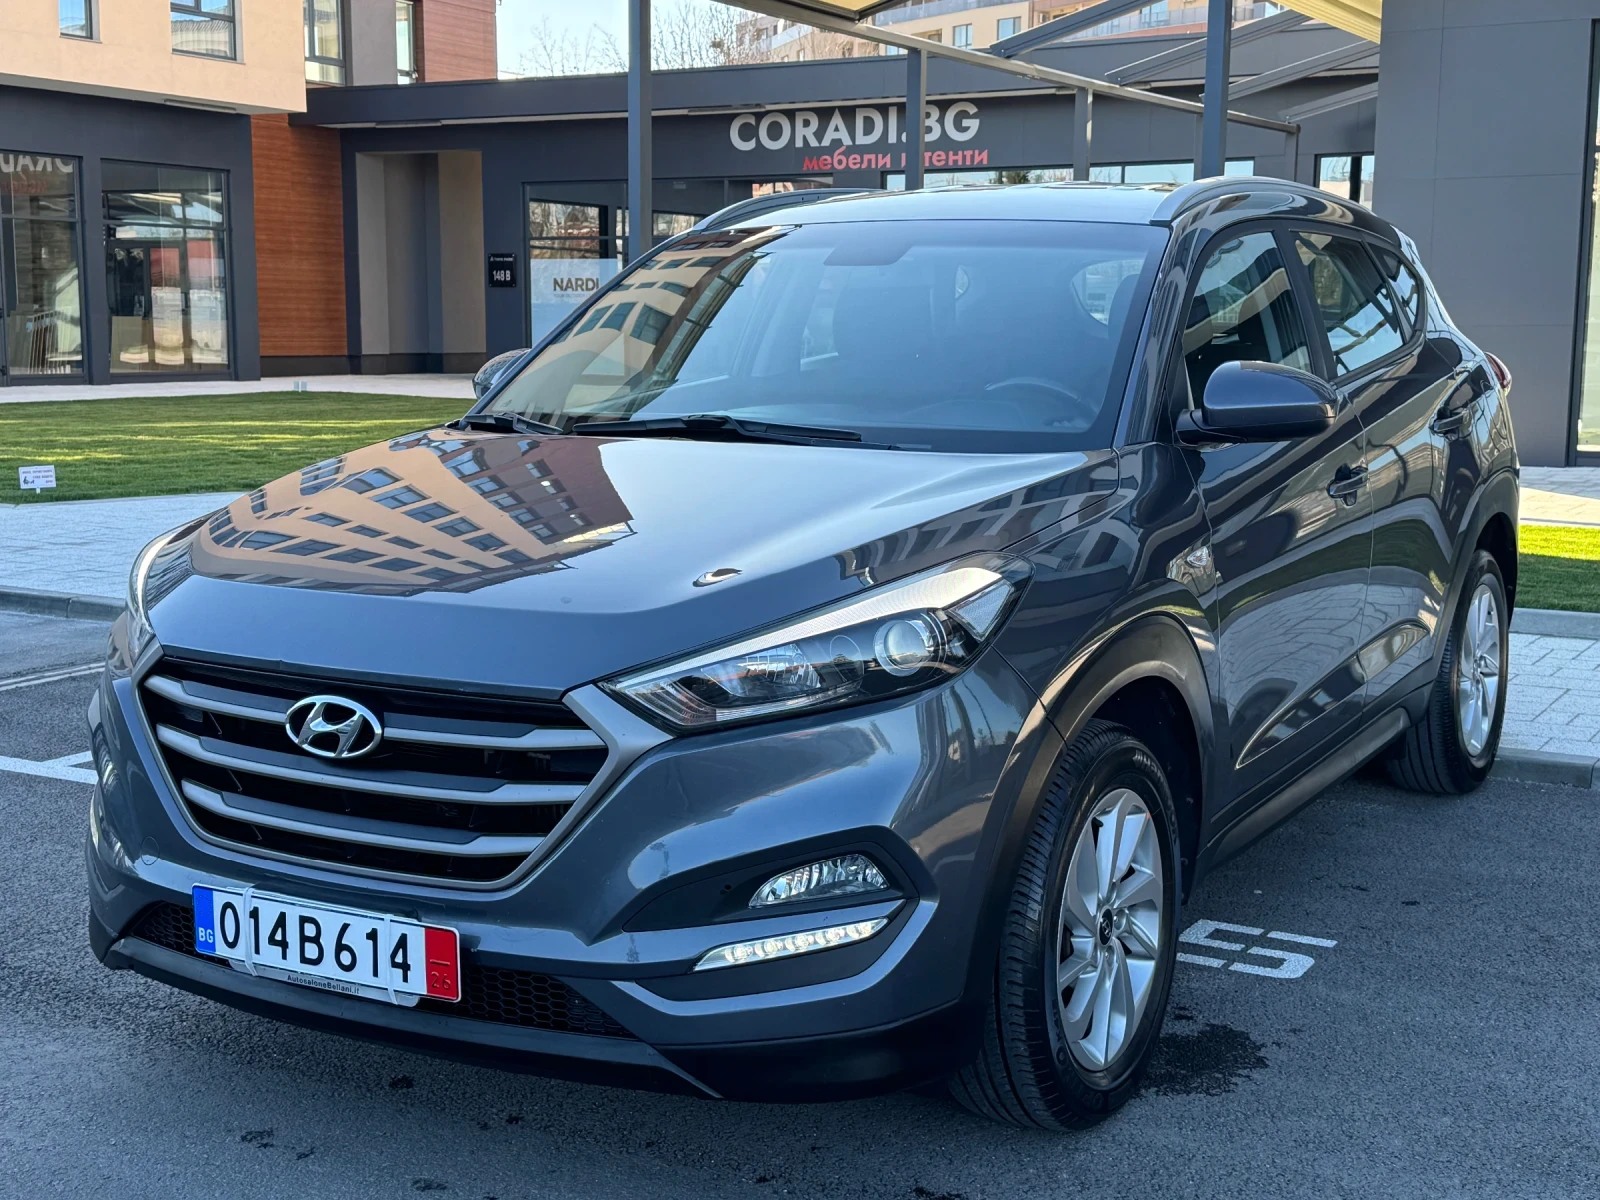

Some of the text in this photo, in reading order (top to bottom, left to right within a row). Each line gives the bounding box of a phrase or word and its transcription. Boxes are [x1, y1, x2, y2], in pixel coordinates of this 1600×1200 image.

[729, 101, 980, 151] CORADI.BG
[803, 146, 891, 171] мебели
[493, 270, 505, 281] 148
[553, 278, 600, 292] NARDI
[199, 927, 214, 943] BG
[219, 901, 411, 983] 014B614
[287, 974, 360, 994] AutosaloneBellani.it
[431, 971, 451, 990] 26
